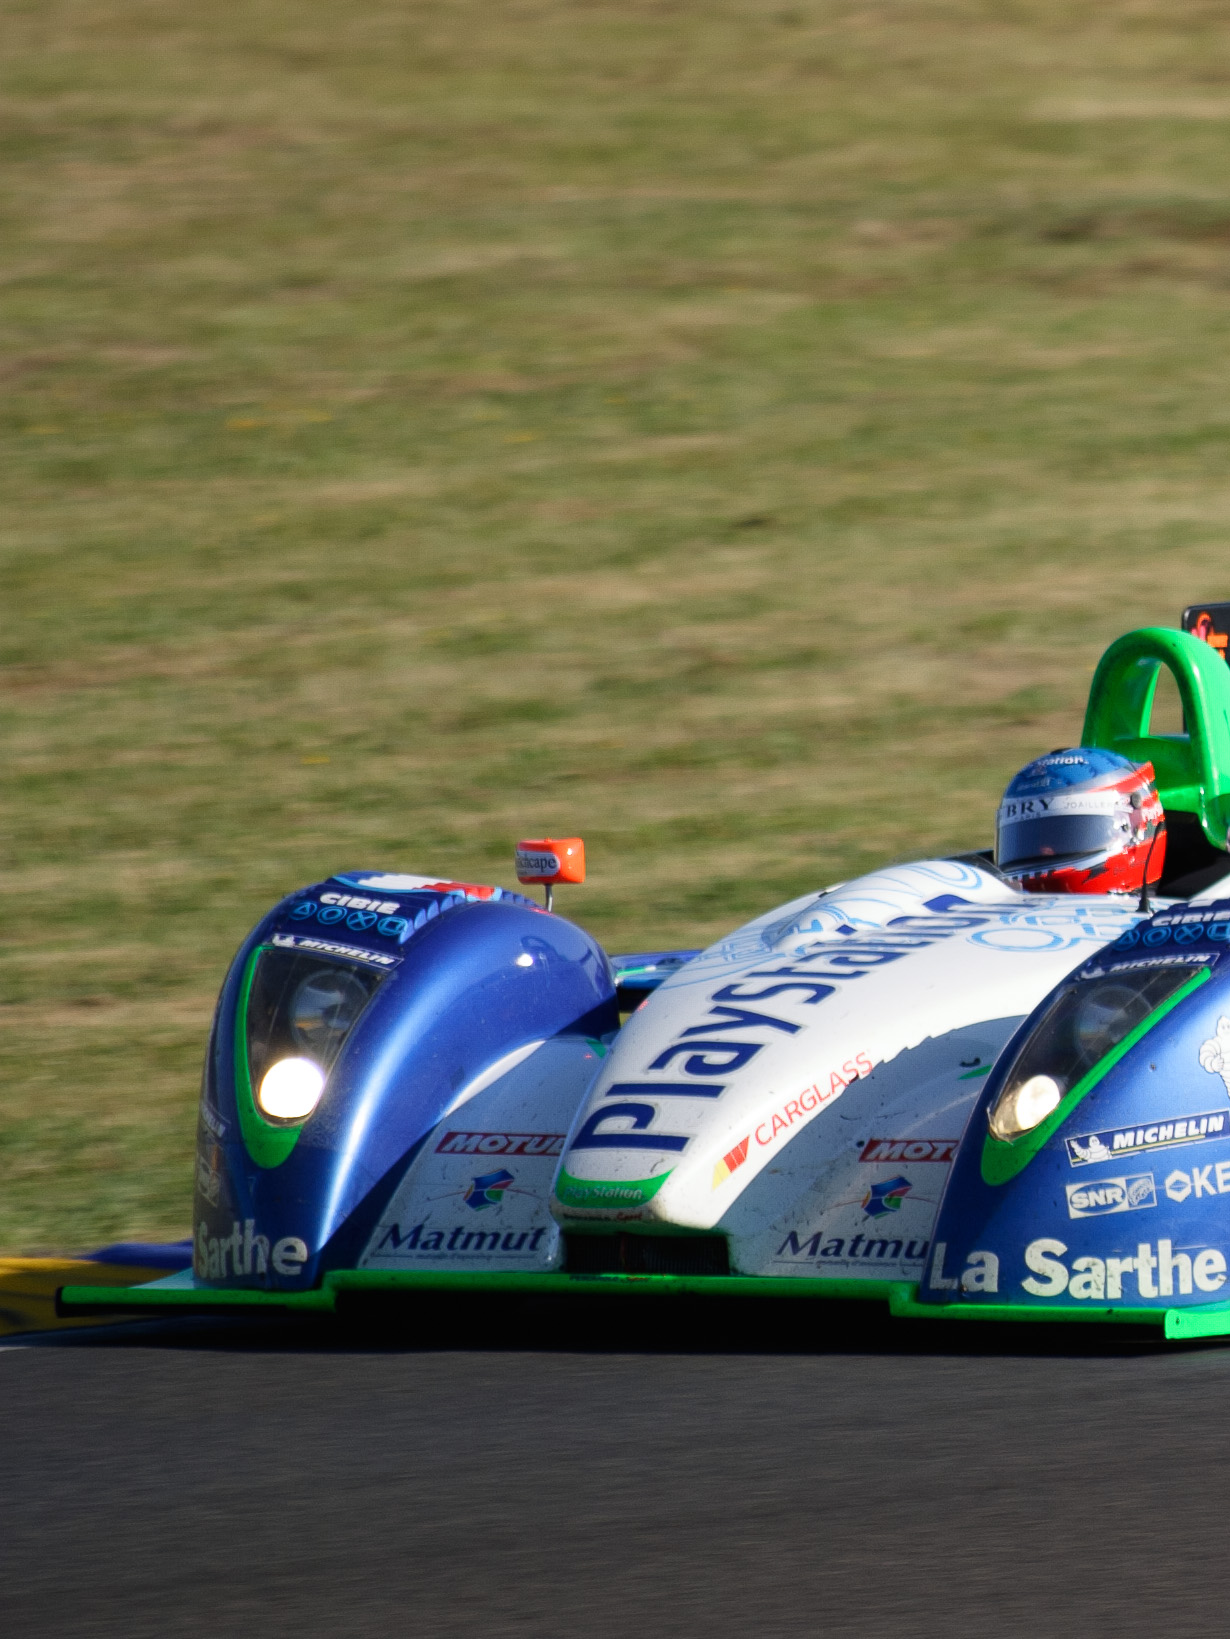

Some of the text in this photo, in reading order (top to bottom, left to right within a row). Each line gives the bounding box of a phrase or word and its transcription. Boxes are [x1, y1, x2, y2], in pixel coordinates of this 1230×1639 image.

[319, 891, 401, 915] CIBIE
[298, 938, 396, 965] MICHELIN
[1109, 952, 1212, 972] MICHELIN
[754, 1052, 873, 1146] CARGLASS
[1112, 1114, 1224, 1150] MICHELIN
[866, 1141, 958, 1161] MOT
[1070, 1186, 1125, 1209] SNR
[377, 1221, 548, 1251] Matmut
[775, 1230, 931, 1260] Matmu
[929, 1237, 1228, 1300] La Sarthe
